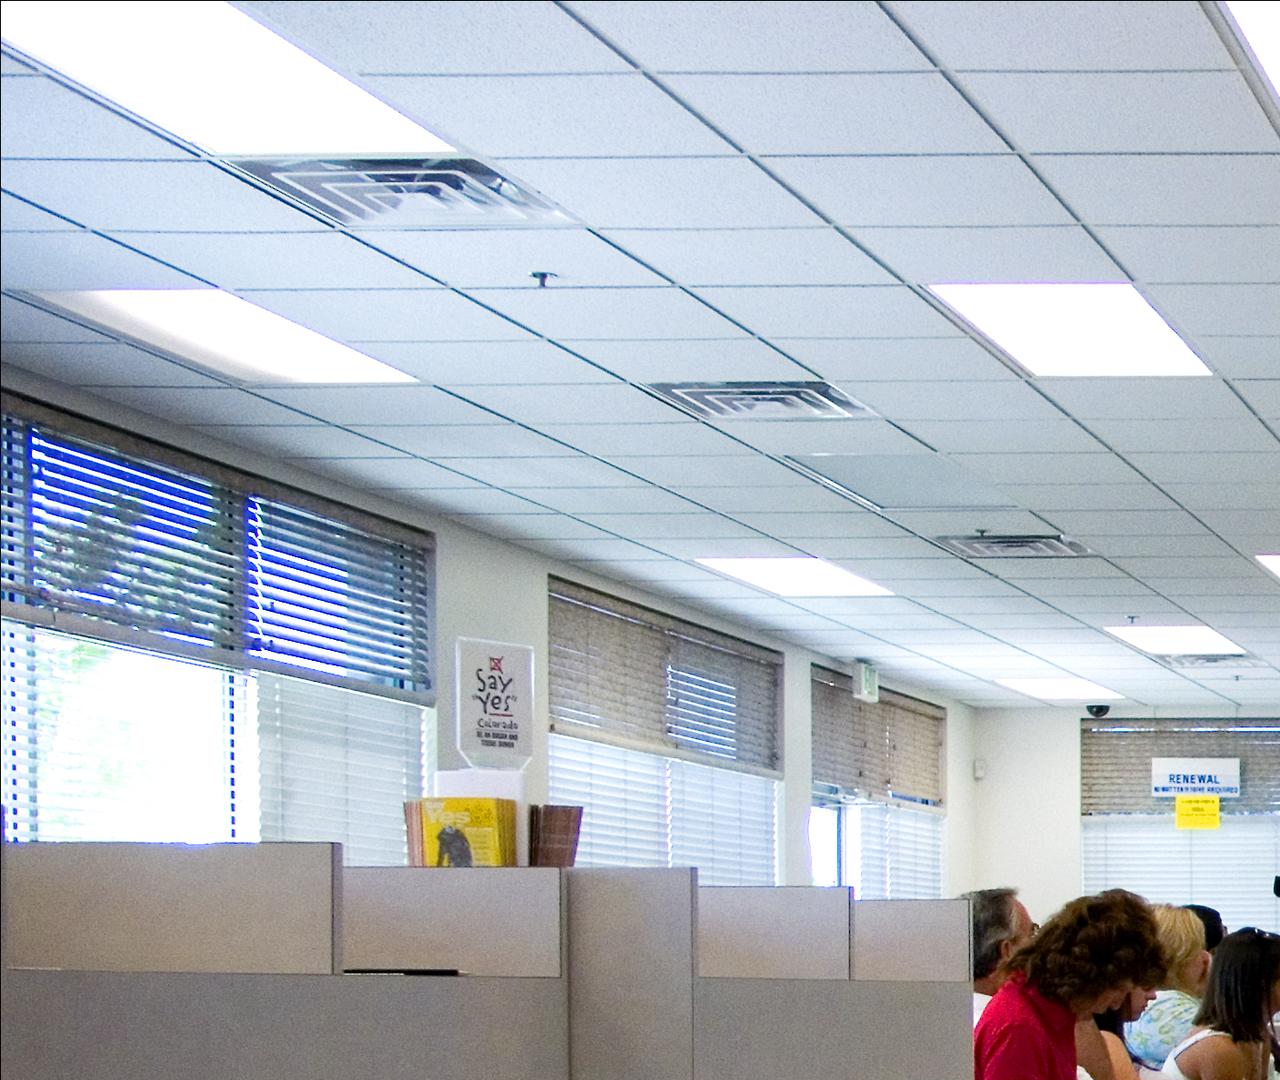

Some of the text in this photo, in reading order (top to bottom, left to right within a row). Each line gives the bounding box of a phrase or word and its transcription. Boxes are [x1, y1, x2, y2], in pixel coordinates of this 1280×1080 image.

[476, 668, 513, 693] Say
[477, 718, 519, 730] Colorado
[1168, 774, 1220, 784] RENEWAL
